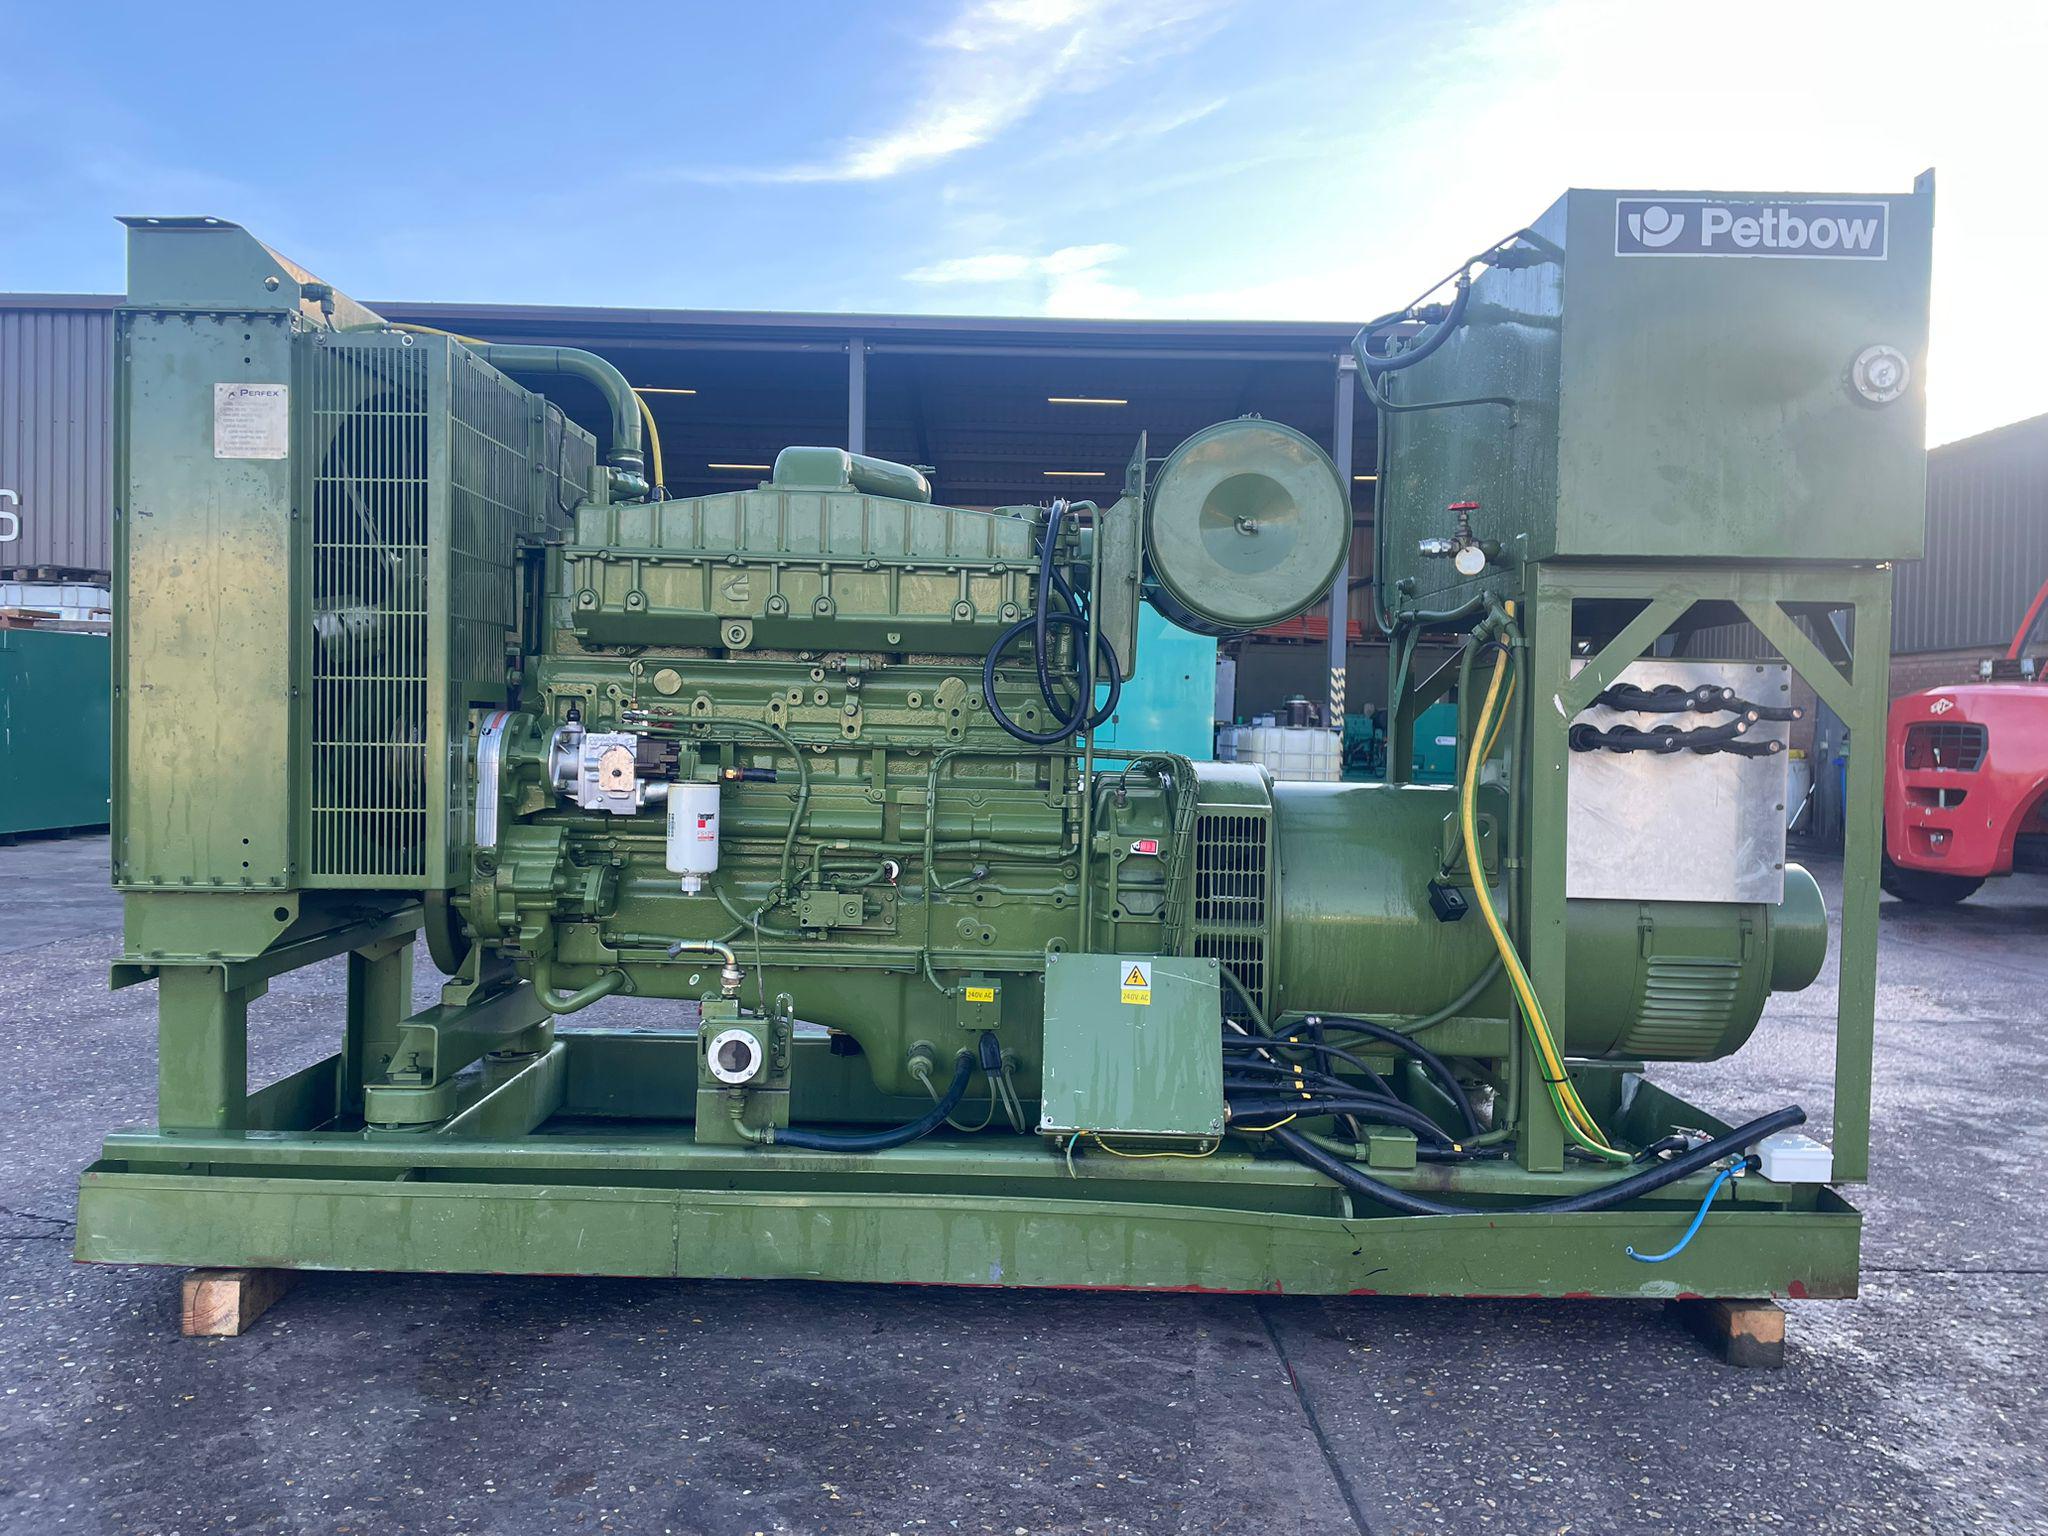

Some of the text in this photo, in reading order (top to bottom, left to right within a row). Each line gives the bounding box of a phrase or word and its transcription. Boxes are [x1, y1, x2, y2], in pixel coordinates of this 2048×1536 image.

[1701, 207, 1878, 250] Petbow
[1122, 992, 1149, 1002] 240V AC
